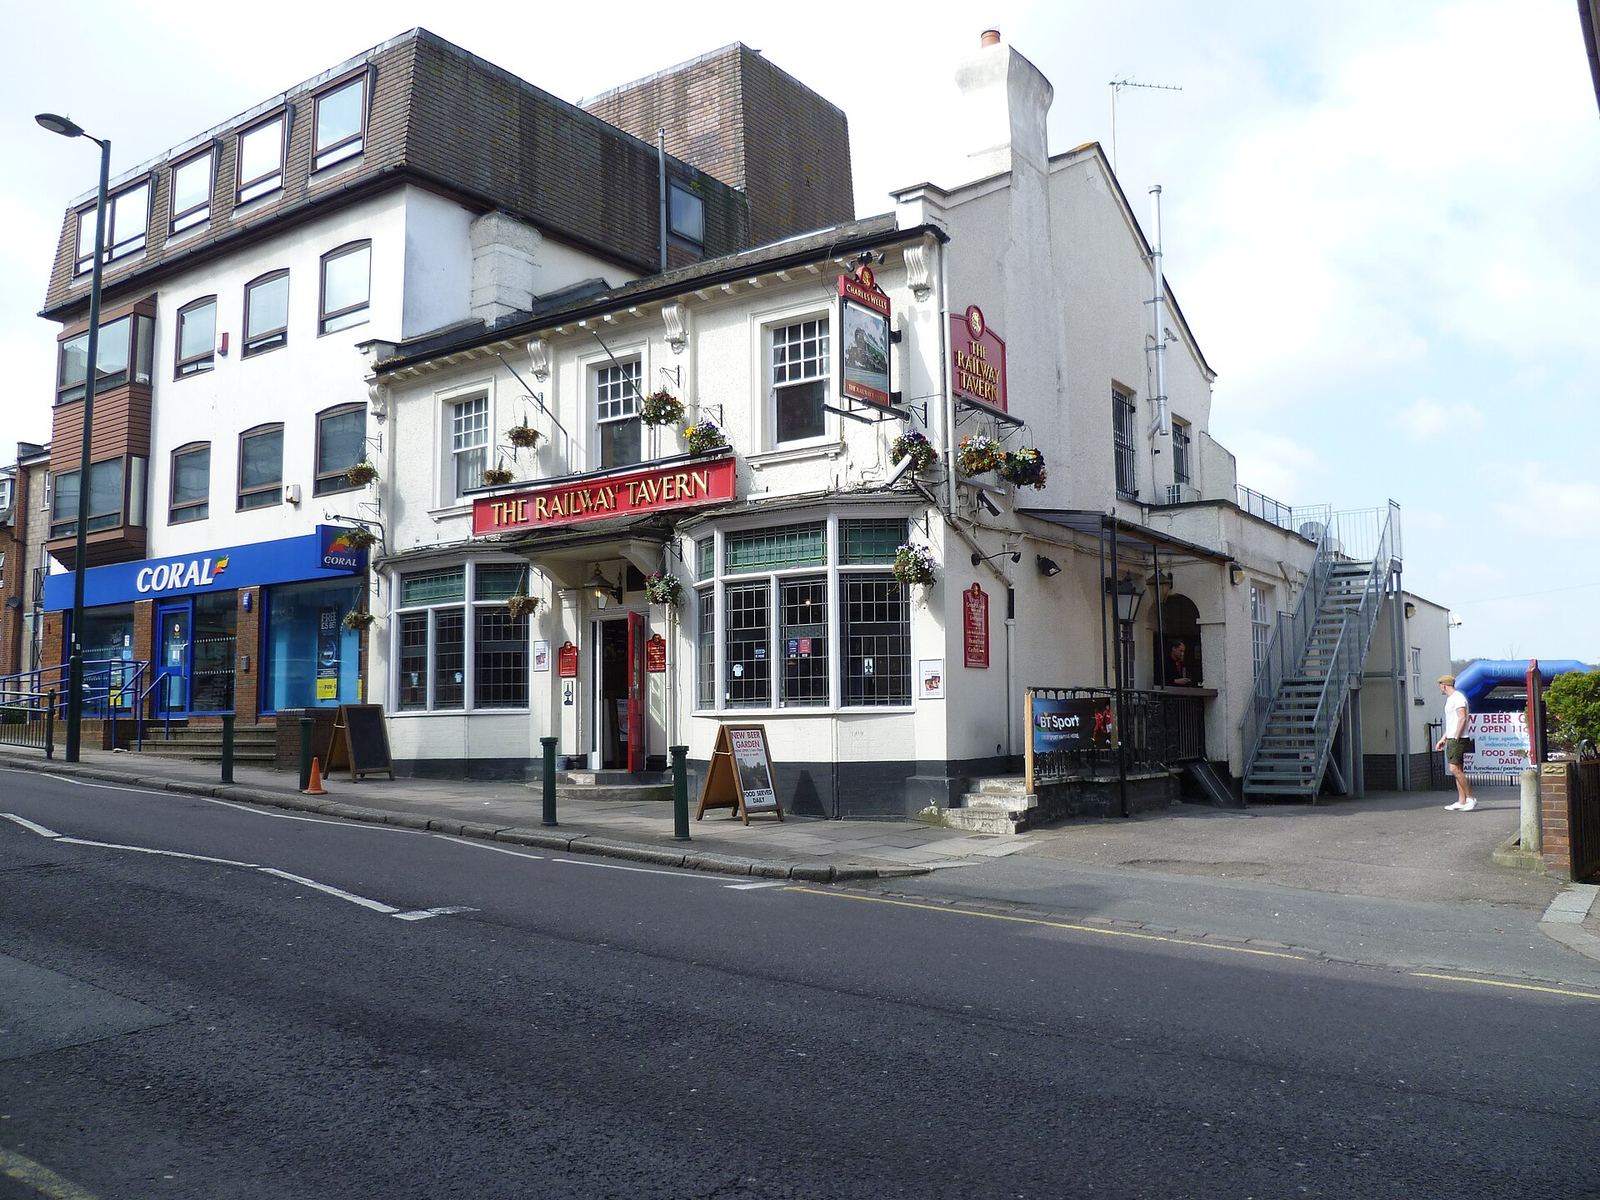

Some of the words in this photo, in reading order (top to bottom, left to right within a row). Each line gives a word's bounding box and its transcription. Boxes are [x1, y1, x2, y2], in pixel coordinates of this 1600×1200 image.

[846, 284, 870, 302] CHARLES
[871, 295, 887, 310] WELLS
[970, 341, 986, 359] THE
[956, 350, 1000, 384] RAILWAY
[959, 371, 998, 403] TAVERN
[491, 499, 528, 525] THE
[536, 484, 619, 520] RAILWAY
[626, 470, 710, 505] TAVERN
[324, 555, 358, 567] CORAL
[137, 558, 214, 593] CORAL
[321, 612, 337, 622] FREE
[1040, 716, 1051, 728] BT
[1052, 714, 1080, 730] Sport
[1483, 714, 1512, 724] BEER
[747, 731, 760, 739] BEER
[1480, 725, 1507, 733] OPEN
[736, 740, 760, 748] GARDEN
[1481, 749, 1505, 757] FOOD
